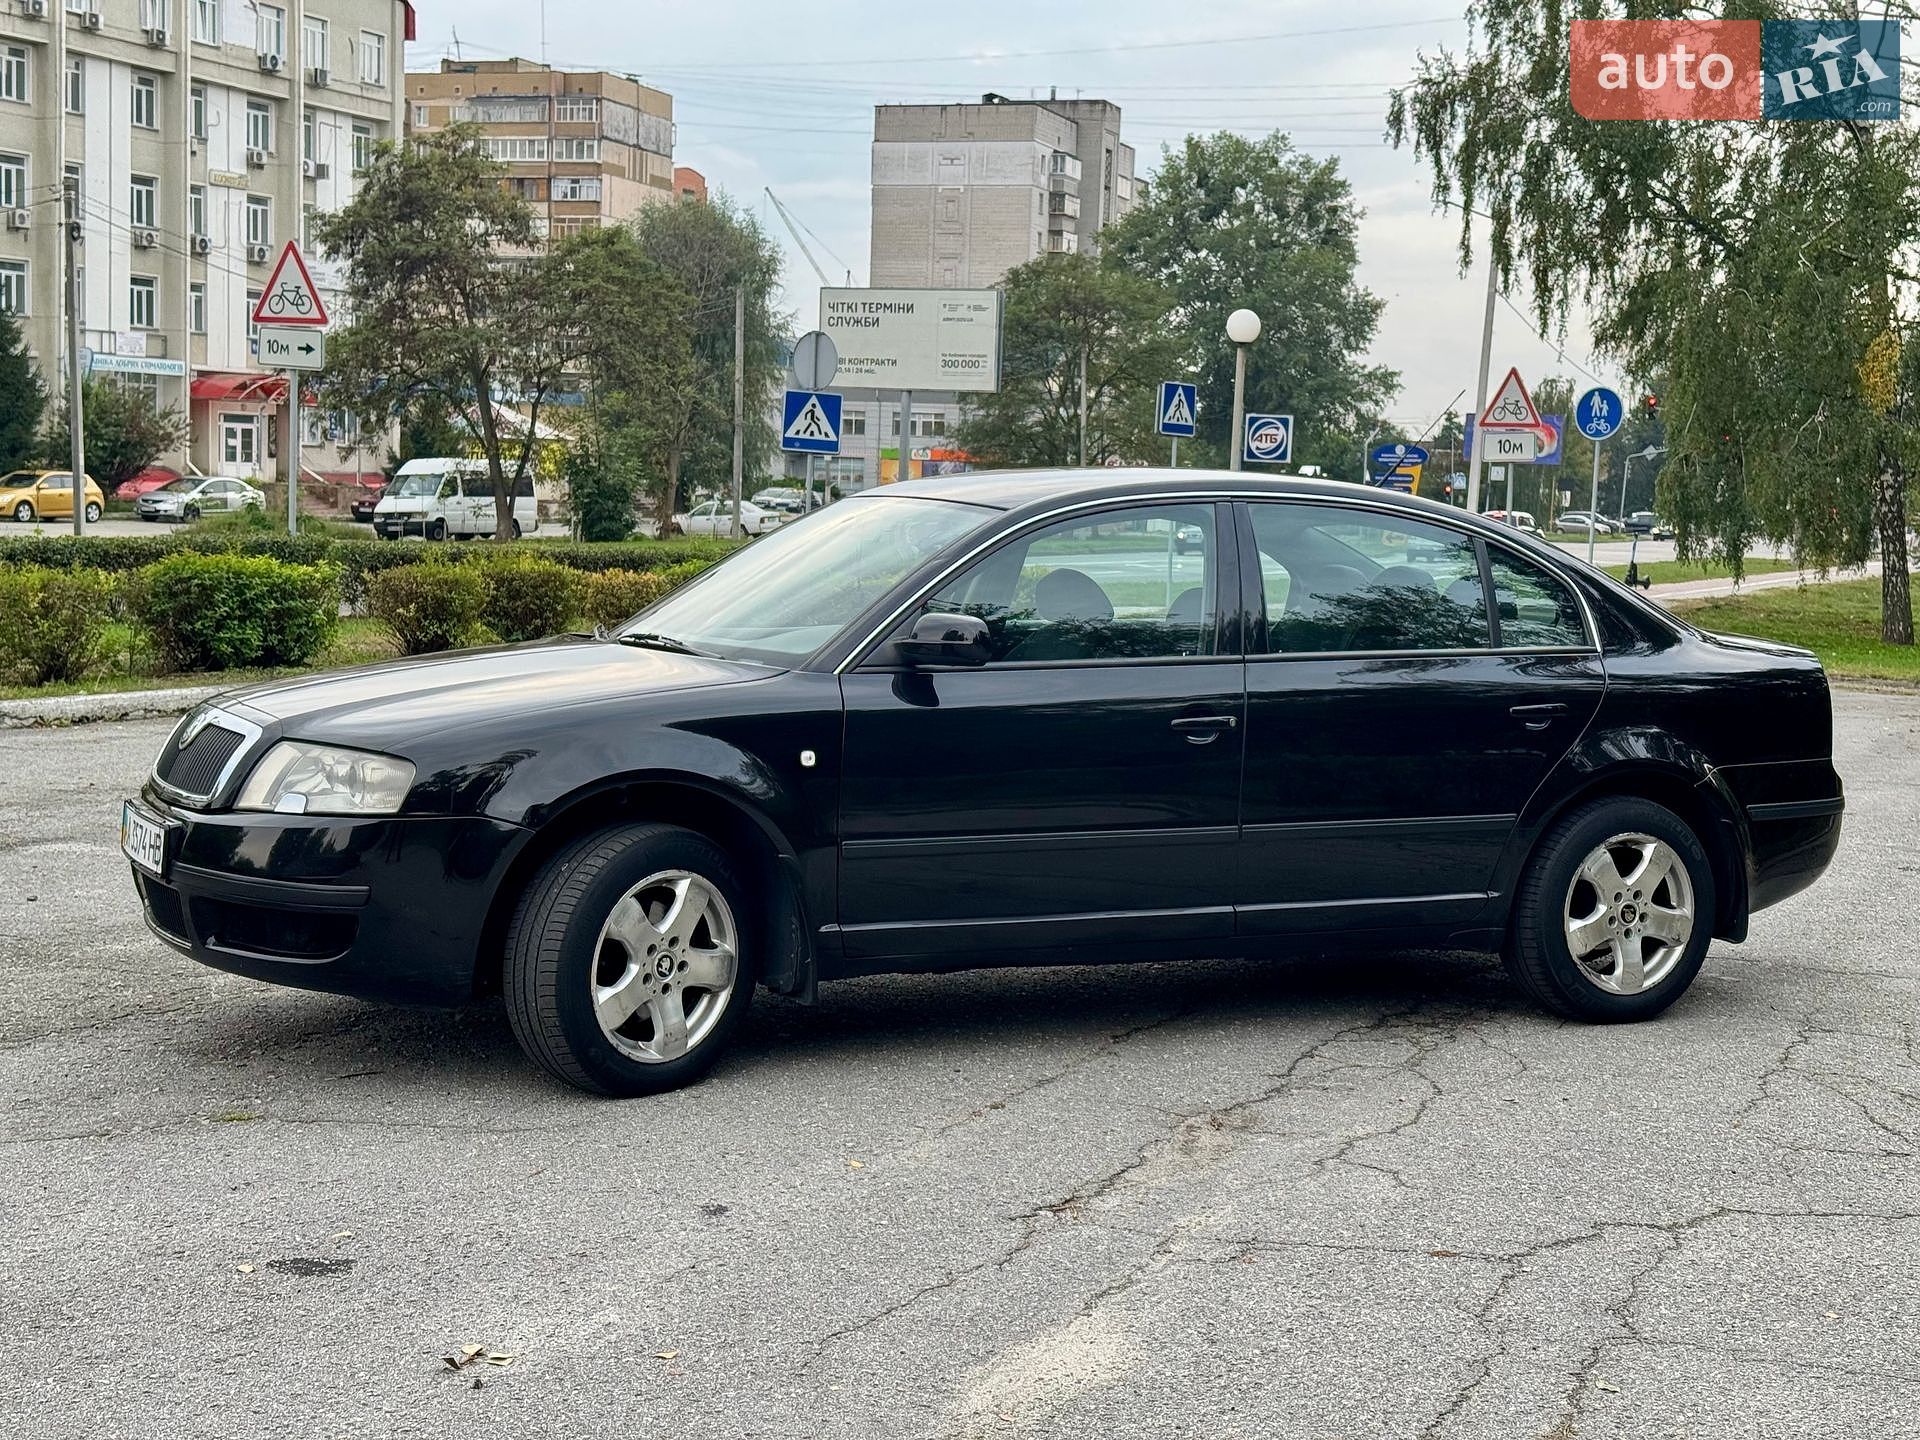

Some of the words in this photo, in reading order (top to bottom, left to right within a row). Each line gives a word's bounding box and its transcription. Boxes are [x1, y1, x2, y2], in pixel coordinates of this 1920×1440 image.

[828, 302, 858, 314] ЧІТКІ
[861, 302, 915, 315] ТЕРМІНИ
[827, 316, 880, 328] СЛУЖБИ
[838, 357, 847, 366] ВІ
[848, 357, 897, 367] КОНТРАКТИ
[1253, 433, 1278, 444] АТБ
[131, 819, 147, 860] 3574
[147, 829, 162, 866] HB
